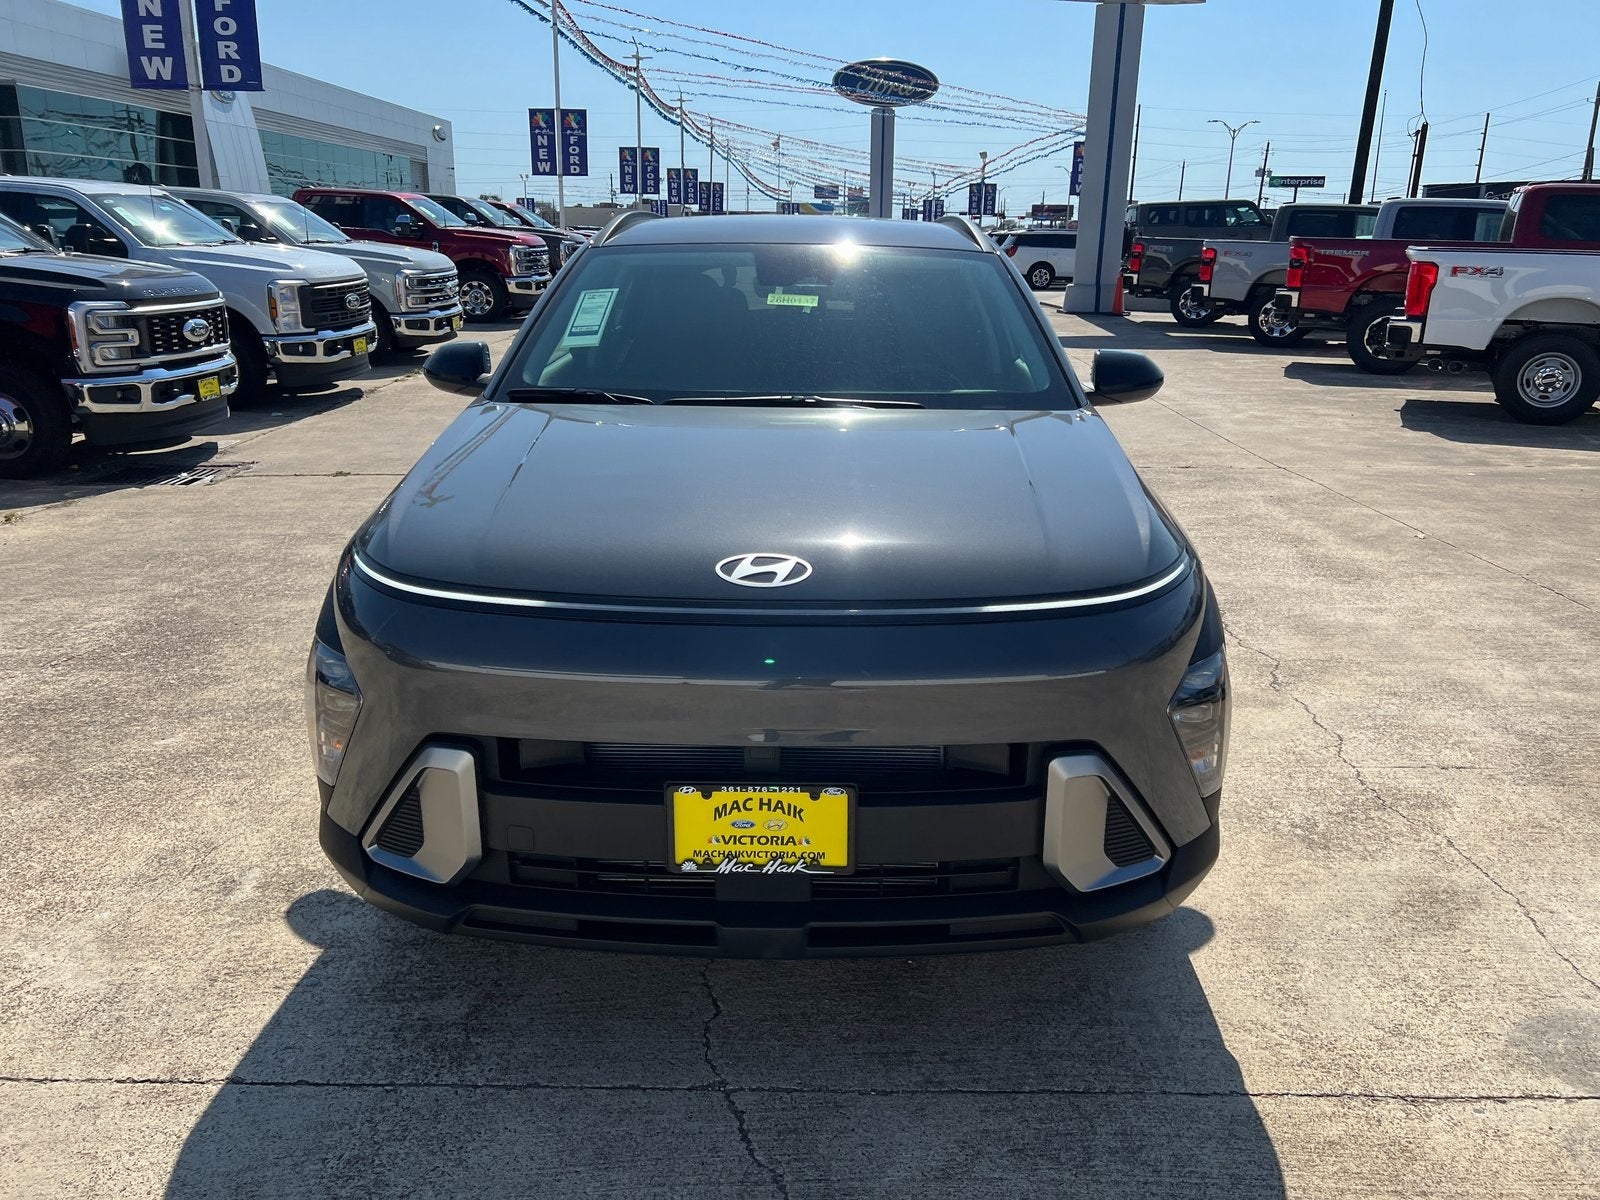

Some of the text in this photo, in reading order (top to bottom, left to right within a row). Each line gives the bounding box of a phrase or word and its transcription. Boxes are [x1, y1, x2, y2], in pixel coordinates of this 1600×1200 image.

[137, 0, 173, 81] NEW
[213, 0, 242, 83] FORD
[537, 135, 551, 172] NEW
[569, 136, 580, 174] FORD
[624, 166, 634, 192] NEW
[646, 166, 655, 193] FORD
[1273, 178, 1325, 187] enterprise
[671, 183, 679, 203] NEW
[1320, 249, 1370, 257] TREMOR
[1450, 266, 1504, 278] FX4
[720, 786, 801, 794] 361-576-1221
[713, 797, 805, 823] MAC HAIK
[720, 834, 798, 846] VICTORIA
[692, 849, 826, 860] MACHAIKVICTORIA.COM
[715, 857, 807, 874] Mac Haik
